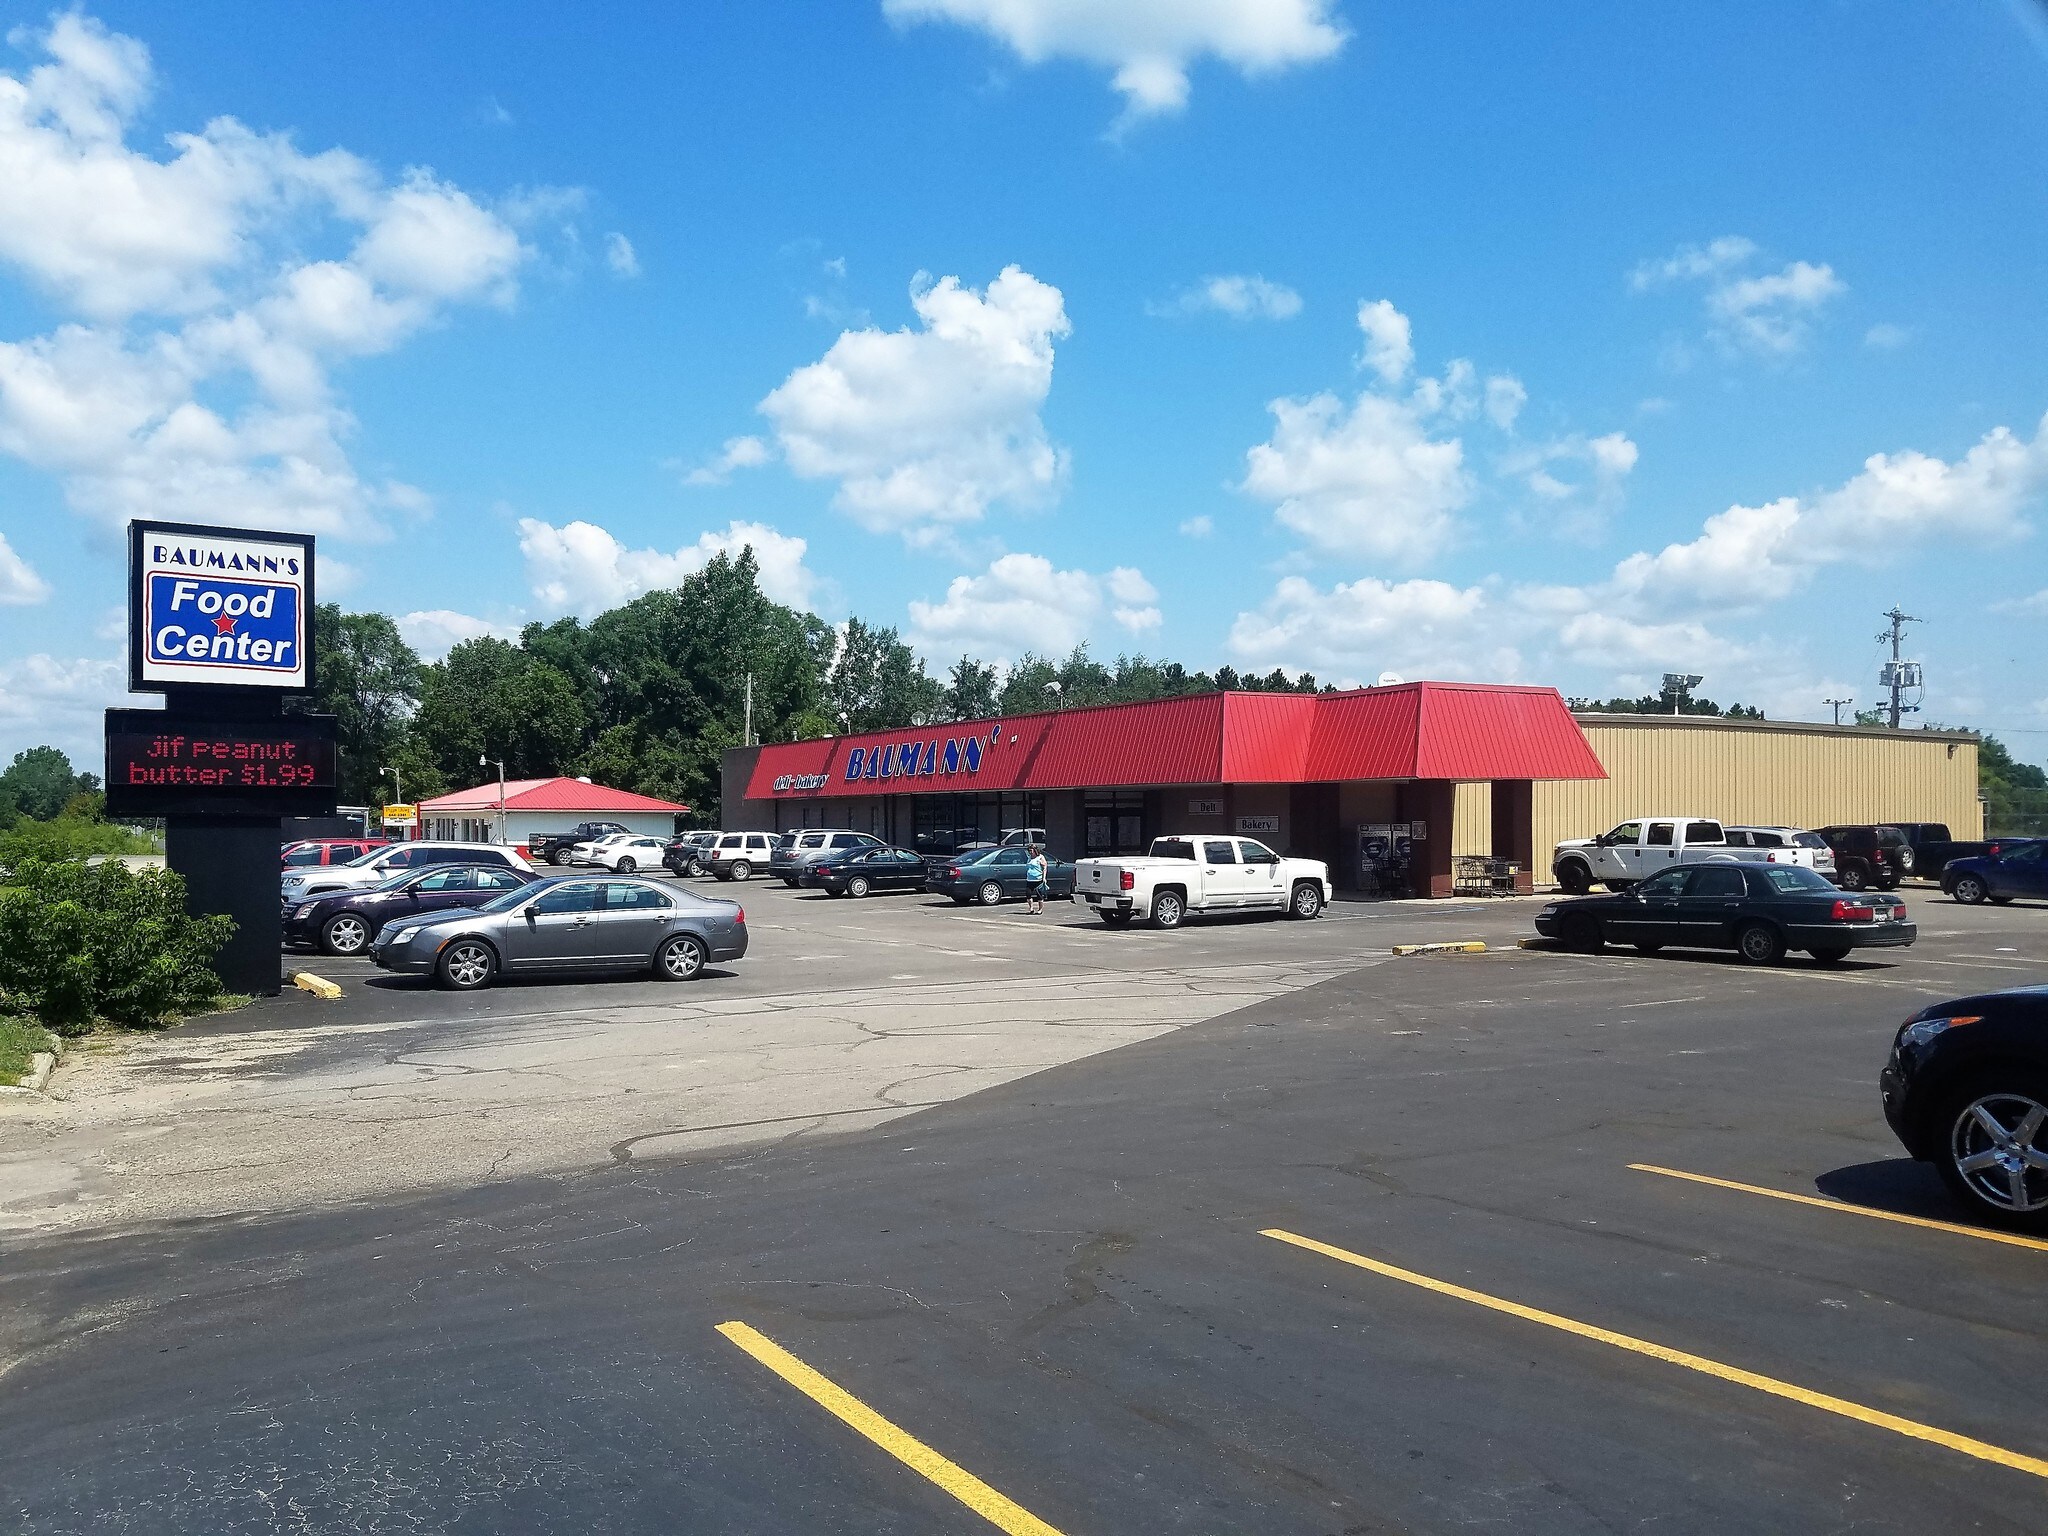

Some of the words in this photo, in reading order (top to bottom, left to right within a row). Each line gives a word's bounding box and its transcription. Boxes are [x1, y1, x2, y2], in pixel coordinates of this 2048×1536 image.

[152, 544, 299, 576] BAUMANN'S
[170, 581, 275, 618] Food
[155, 624, 292, 663] Center
[129, 761, 233, 785] butter
[241, 763, 315, 786] $1.99
[1242, 820, 1272, 830] Bakery
